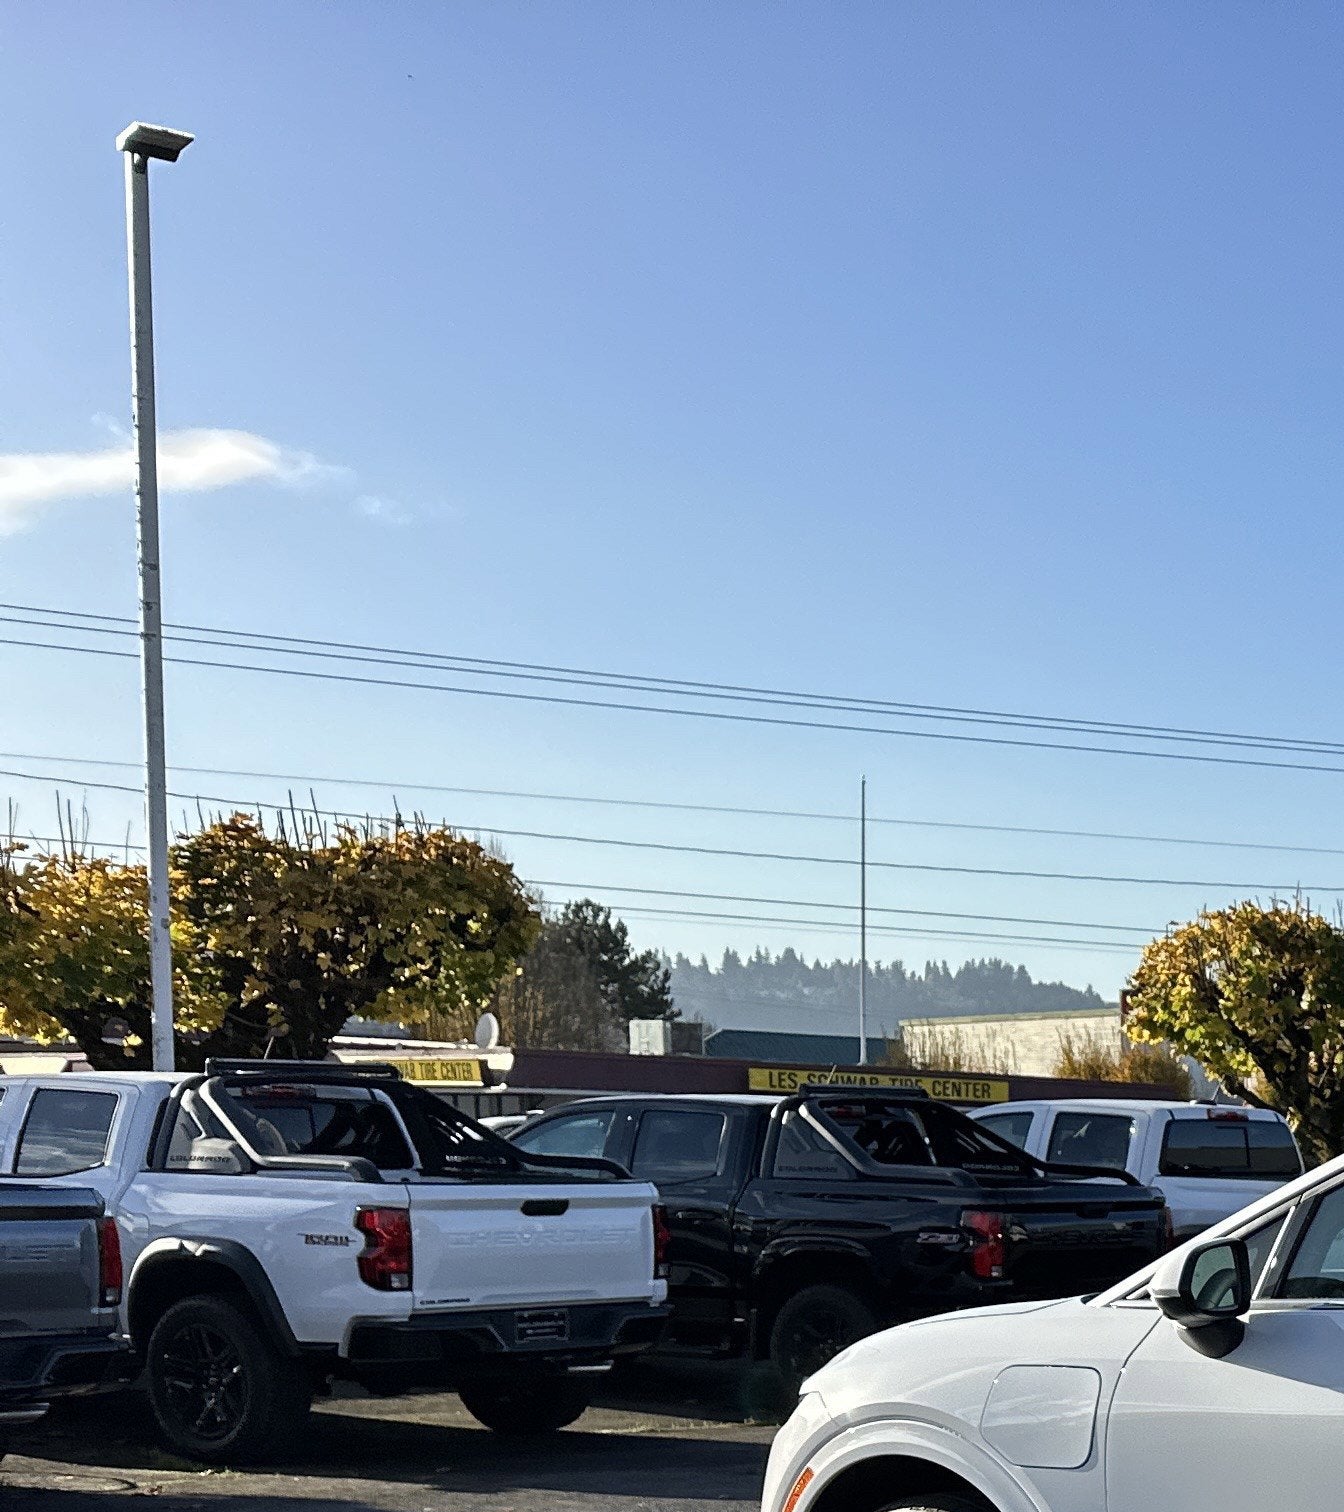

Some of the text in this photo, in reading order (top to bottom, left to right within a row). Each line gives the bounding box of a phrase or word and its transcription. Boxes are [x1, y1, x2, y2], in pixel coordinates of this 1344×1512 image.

[441, 1062, 473, 1080] CENTER
[768, 1071, 798, 1089] LES
[931, 1080, 991, 1099] CENTER
